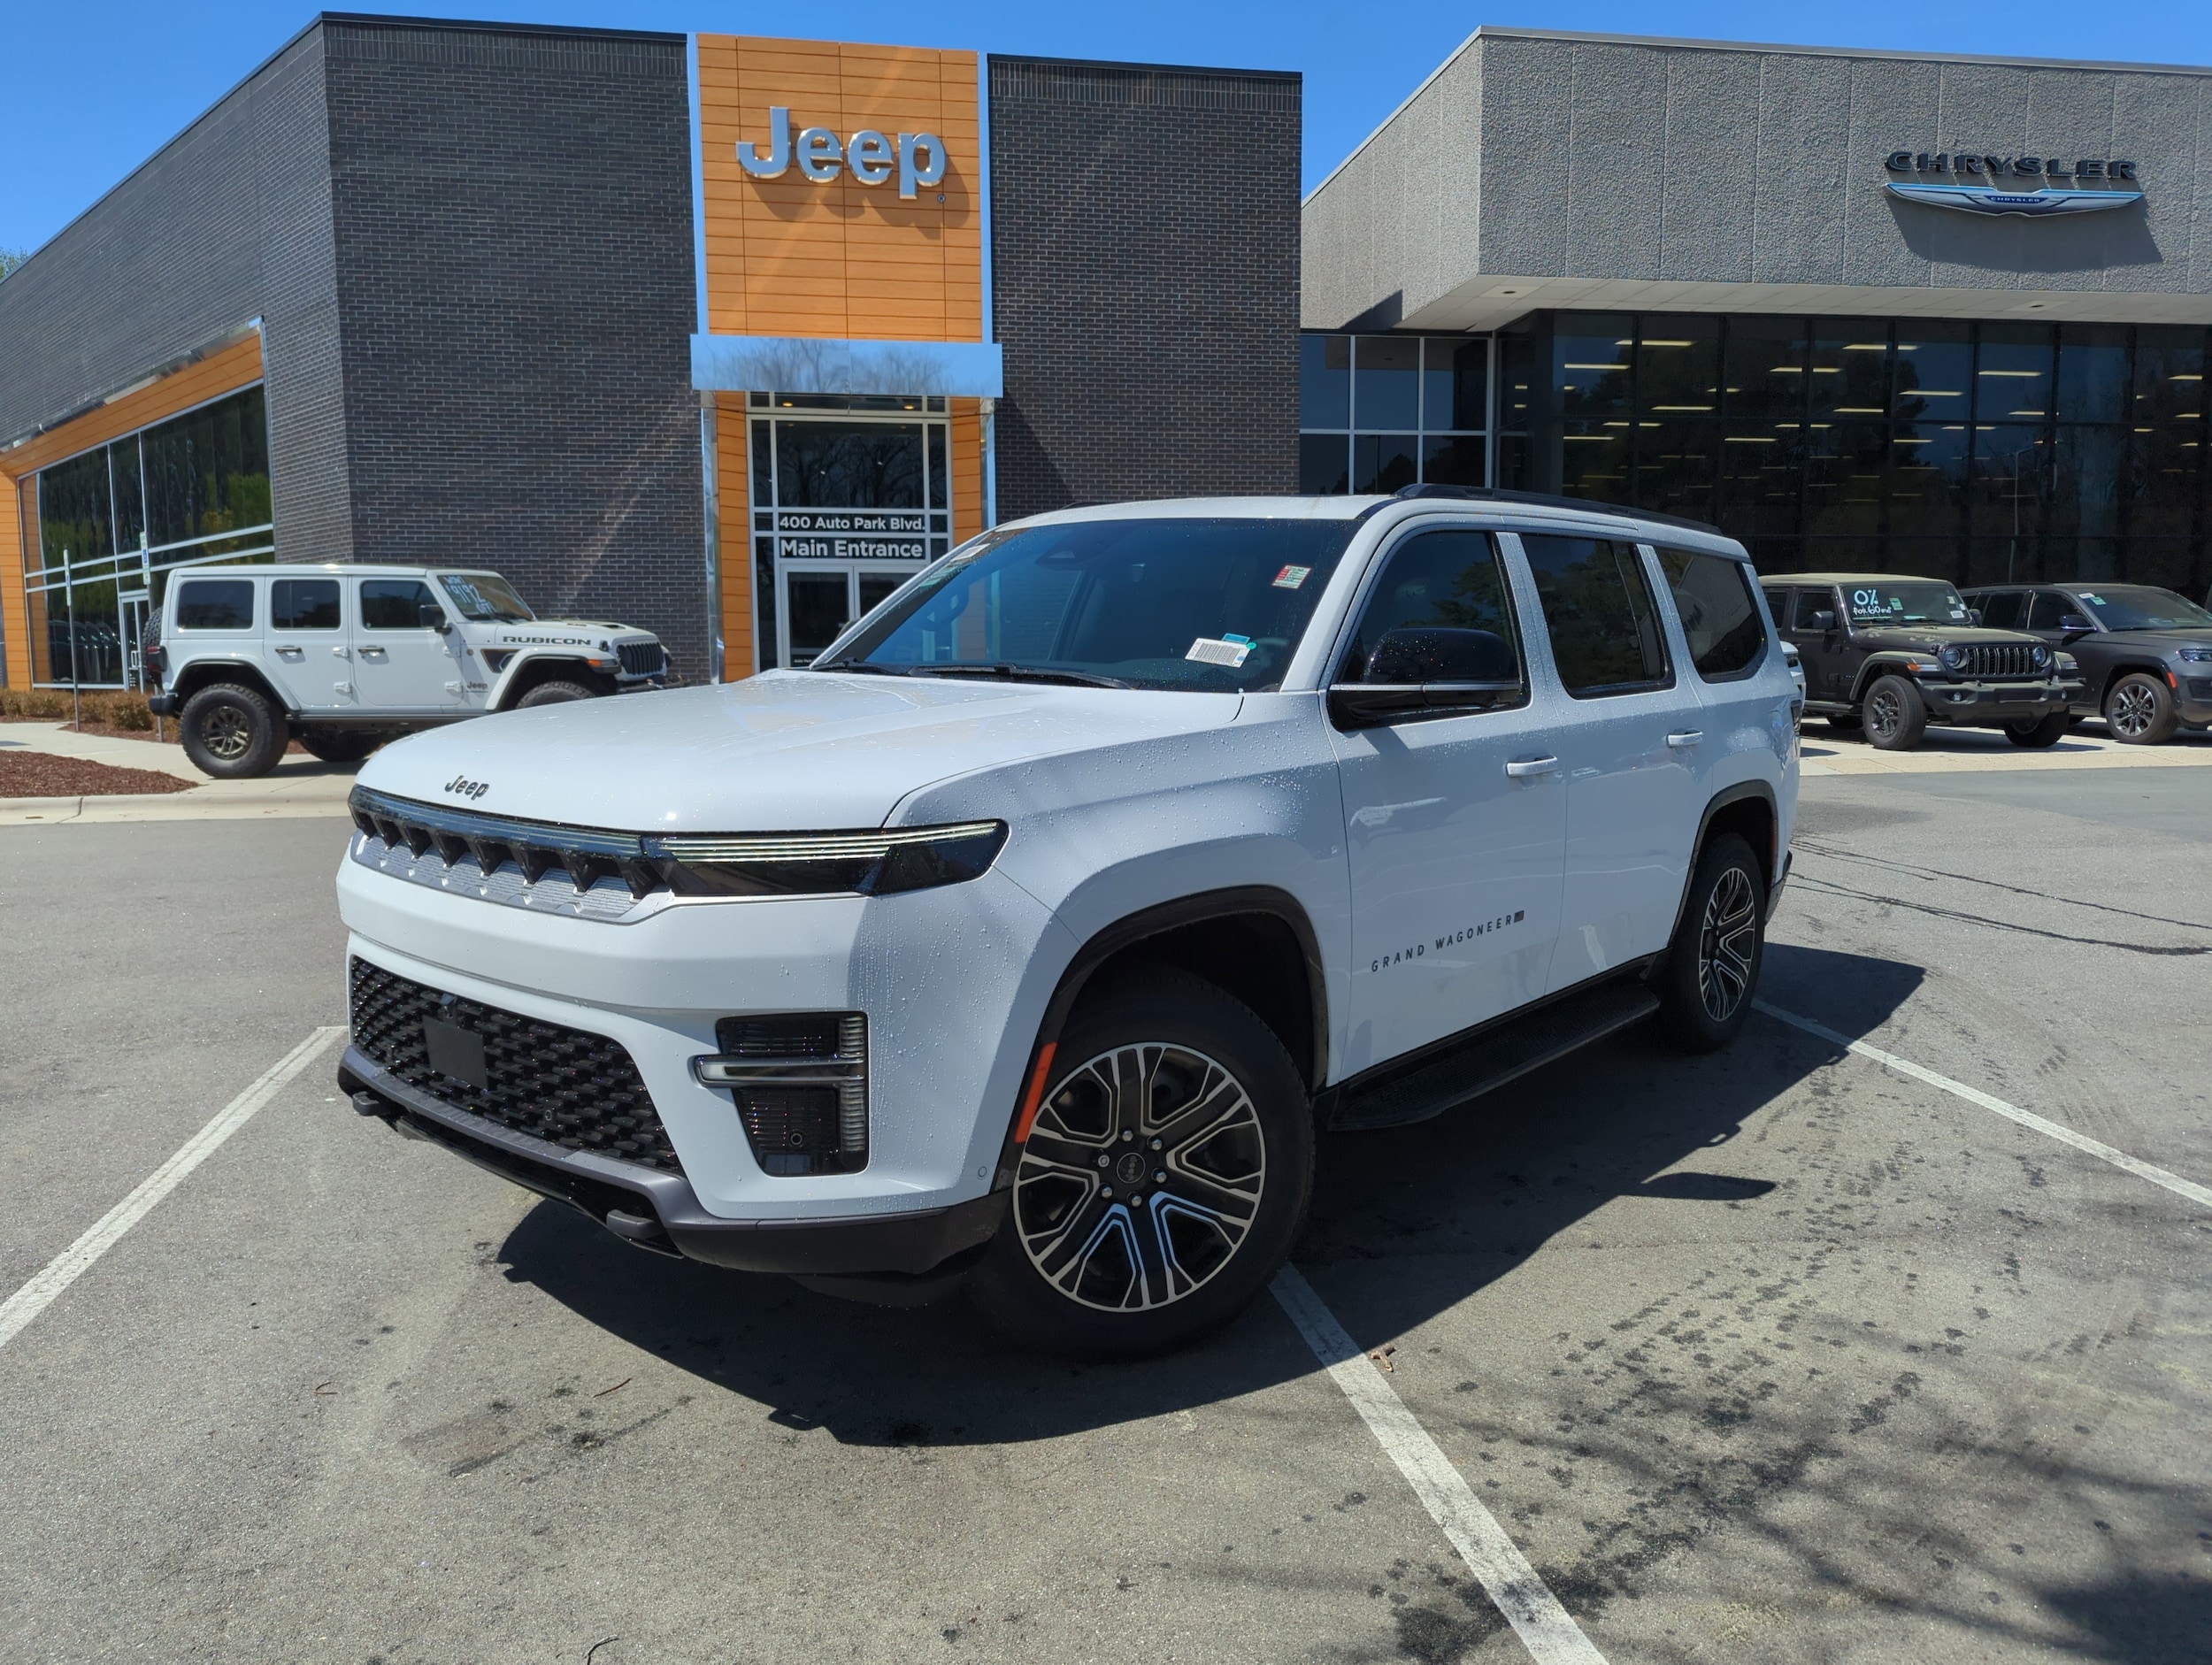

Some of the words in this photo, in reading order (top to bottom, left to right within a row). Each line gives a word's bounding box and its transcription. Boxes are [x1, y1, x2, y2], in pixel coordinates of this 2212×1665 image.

[736, 106, 948, 199] Jeep
[1885, 151, 2137, 178] CHRYSLER
[780, 517, 810, 529] 400
[815, 518, 849, 529] Auto
[855, 518, 886, 529] Park
[890, 518, 926, 530] Blvd.
[780, 539, 828, 556] Main
[834, 540, 923, 557] Entrance
[1854, 589, 1878, 605] 0%
[503, 636, 591, 645] RUBICON
[444, 775, 489, 801] Jeep
[1371, 944, 1425, 972] GRAND
[1435, 915, 1511, 949] WAGONEER
